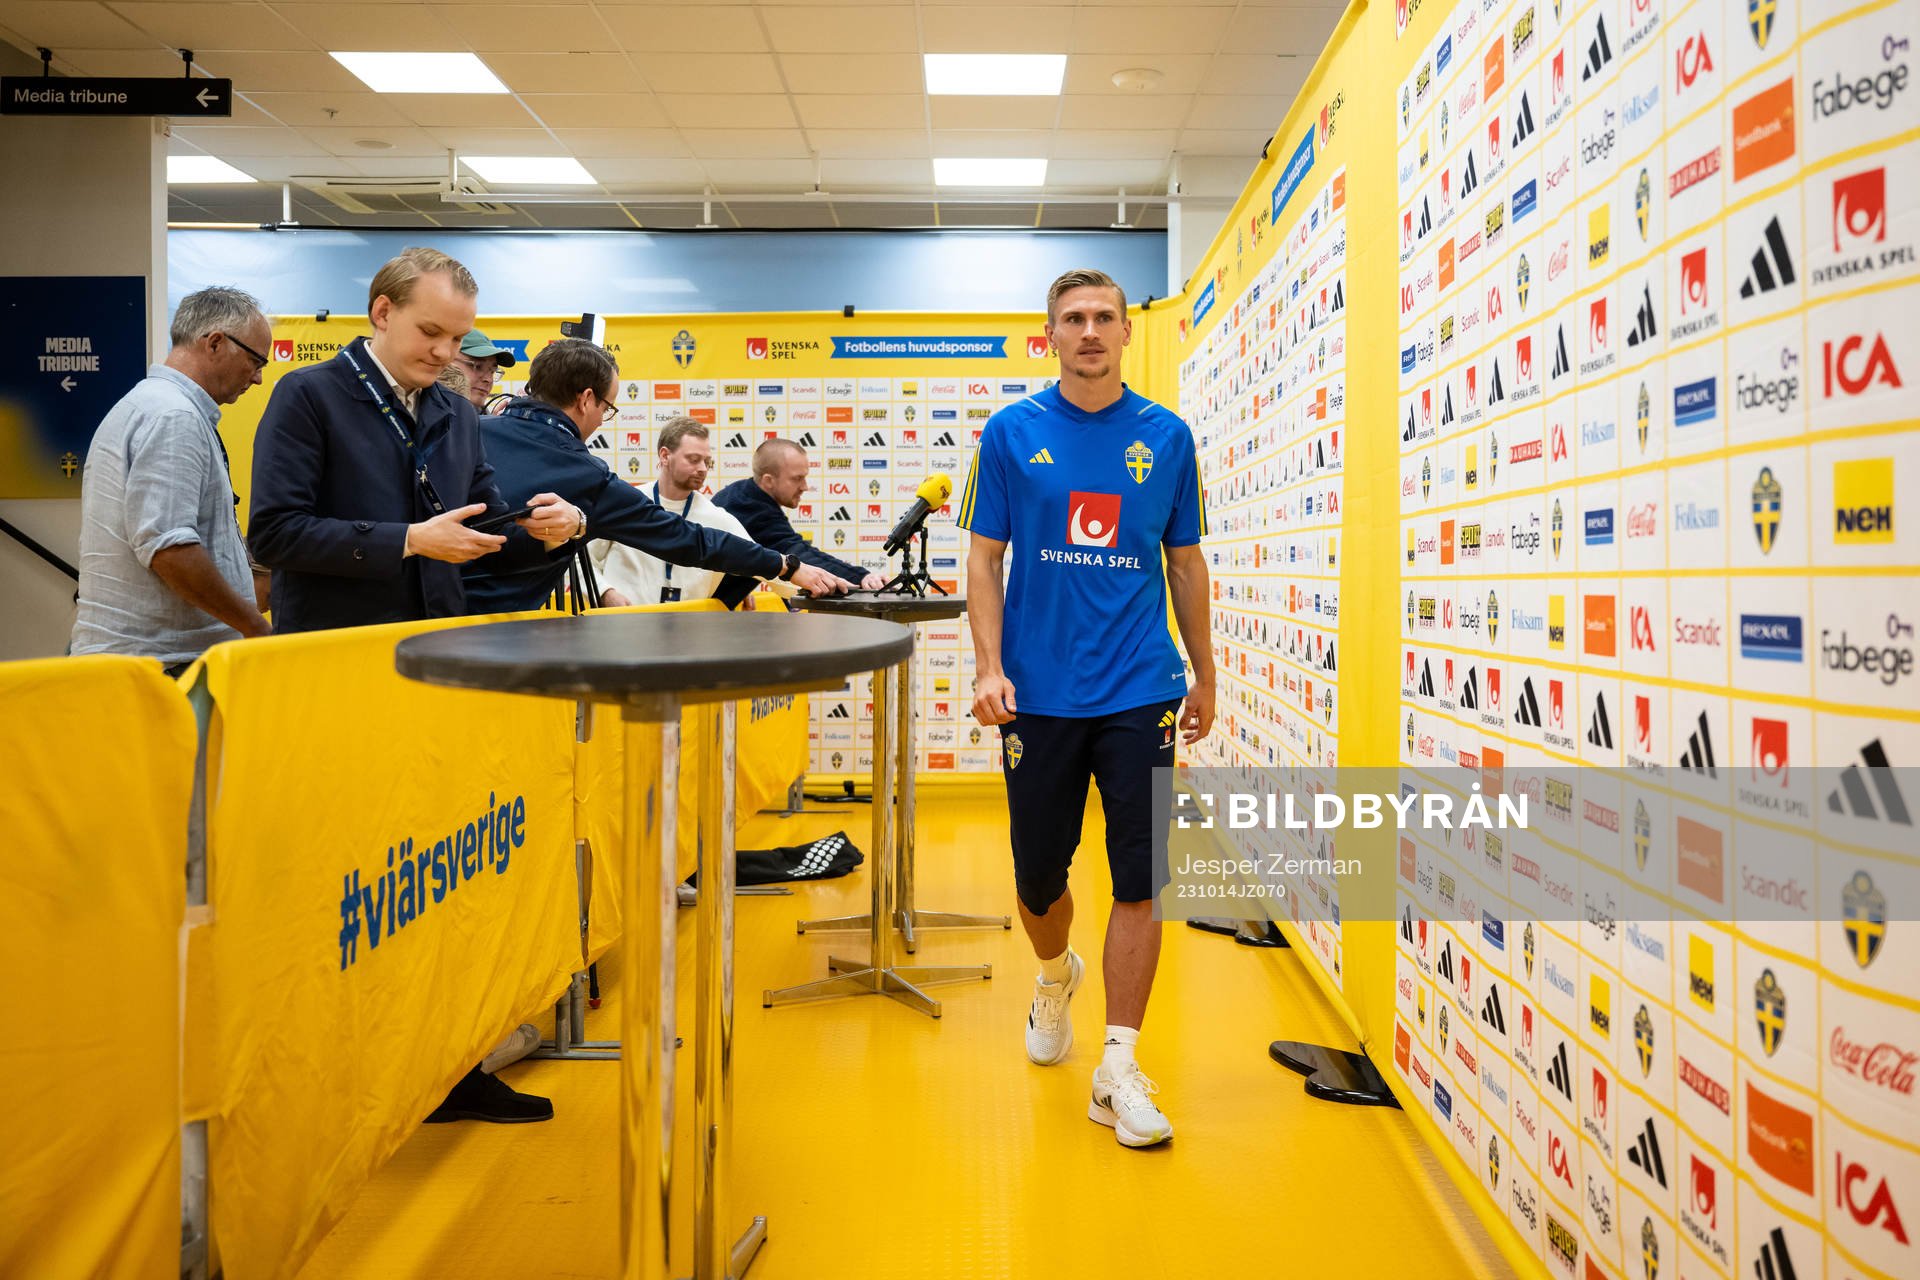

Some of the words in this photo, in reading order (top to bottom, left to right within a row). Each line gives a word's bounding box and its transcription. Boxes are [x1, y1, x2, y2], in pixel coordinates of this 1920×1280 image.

[1676, 29, 1713, 96] ICA
[14, 88, 65, 103] Media
[70, 89, 128, 104] tribune
[1812, 64, 1908, 121] Fabege
[1581, 129, 1615, 167] Fabege
[1669, 147, 1720, 198] BAUHAUS
[1812, 257, 1873, 285] SVENSKA
[1879, 247, 1915, 269] SPEL
[1488, 286, 1502, 323] ICA
[46, 337, 92, 353] MEDIA
[297, 343, 343, 351] SVENSKA
[297, 352, 322, 361] SPEL
[771, 341, 819, 350] SVENSKA
[771, 351, 796, 359] SPEL
[844, 341, 906, 353] Fotbollens
[908, 341, 993, 354] huvudsponsor
[38, 355, 100, 372] TRIBUNE
[1823, 332, 1903, 399] ICA
[689, 387, 715, 398] Fabege
[827, 386, 851, 396] Fabege
[969, 384, 989, 395] ICA
[1737, 372, 1798, 413] Fabege
[863, 409, 887, 418] SPORT
[967, 408, 991, 418] SPORT
[828, 458, 852, 468] SPORT
[932, 459, 957, 470] Fabege
[829, 484, 850, 494] ICA
[1675, 503, 1719, 531] Folksam
[1461, 525, 1481, 548] SPORT
[1512, 525, 1540, 554] Fabege
[861, 557, 887, 568] Fabege
[1040, 549, 1104, 567] SVENSKA
[1108, 555, 1142, 569] SPEL
[1443, 599, 1453, 629] IC
[1512, 609, 1543, 630] Folksam
[1631, 606, 1655, 652] ICA
[1675, 617, 1721, 646] Scandic
[929, 658, 955, 668] Fabege
[1822, 629, 1913, 685] Fabege
[928, 732, 953, 742] Fabege
[340, 791, 525, 972] #viärsverige
[1741, 865, 1808, 912] Scandic
[1585, 893, 1616, 941] Fabege
[1830, 1026, 1919, 1095] Coca-Cola
[1679, 1056, 1730, 1116] BAUHAUS
[1548, 1129, 1574, 1190] ICA
[1512, 1178, 1537, 1230] Fabege
[1588, 1173, 1611, 1234] Fabege
[1836, 1150, 1910, 1246] ICA
